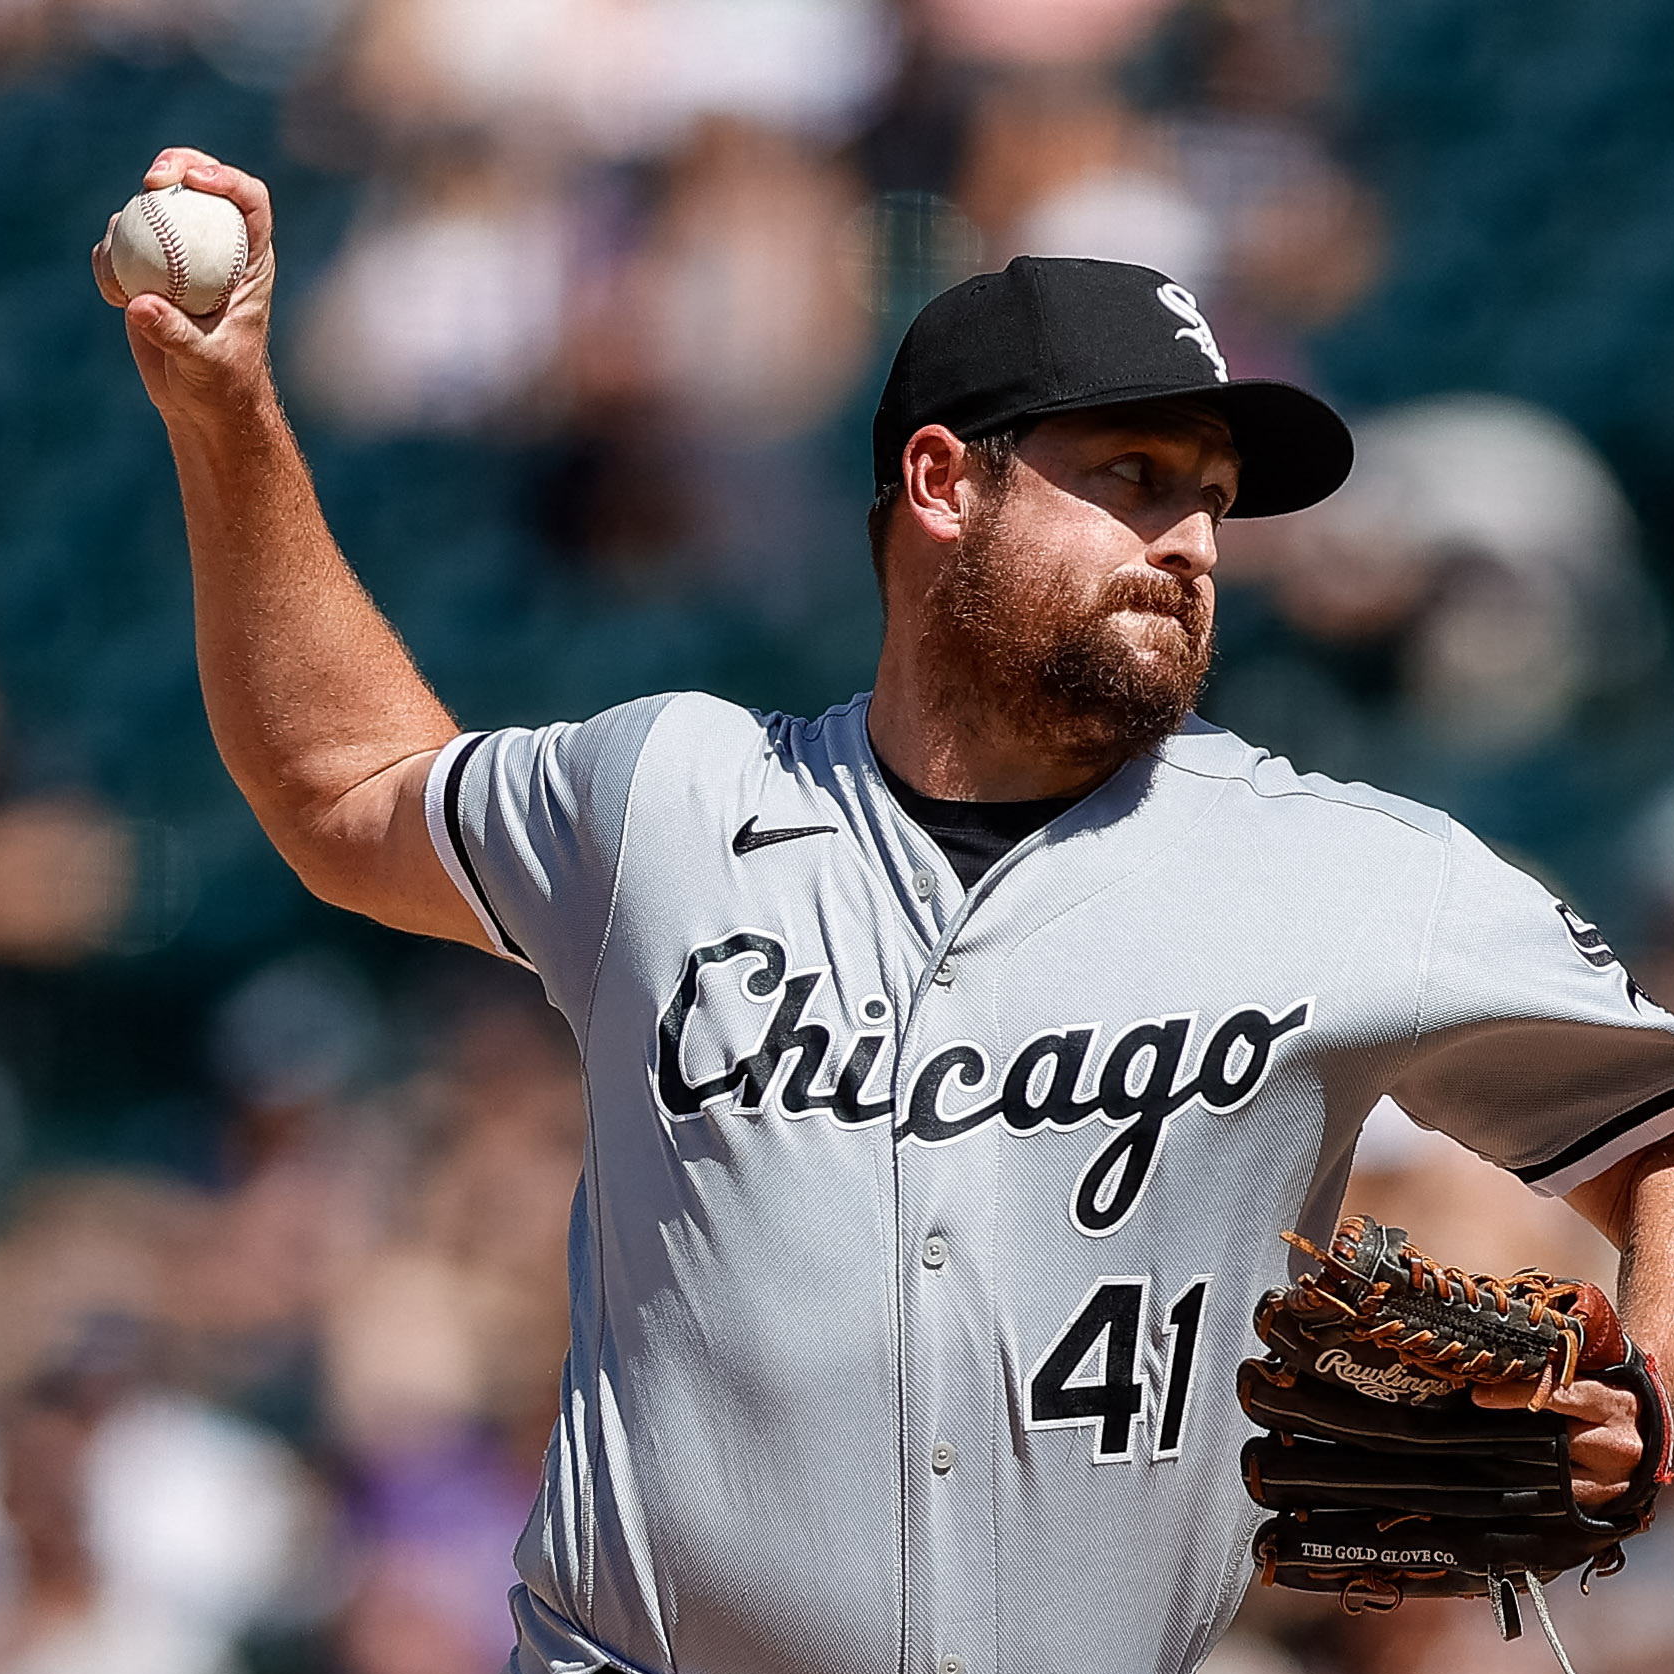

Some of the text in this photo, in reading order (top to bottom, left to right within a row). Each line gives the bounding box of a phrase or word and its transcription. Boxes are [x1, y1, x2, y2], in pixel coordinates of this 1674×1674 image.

[655, 929, 1317, 1238] Chicago
[1024, 1274, 1216, 1465] 41
[1314, 1348, 1453, 1406] Rawlings
[1301, 1542, 1458, 1566] THE GOLD GLOVE CO.
